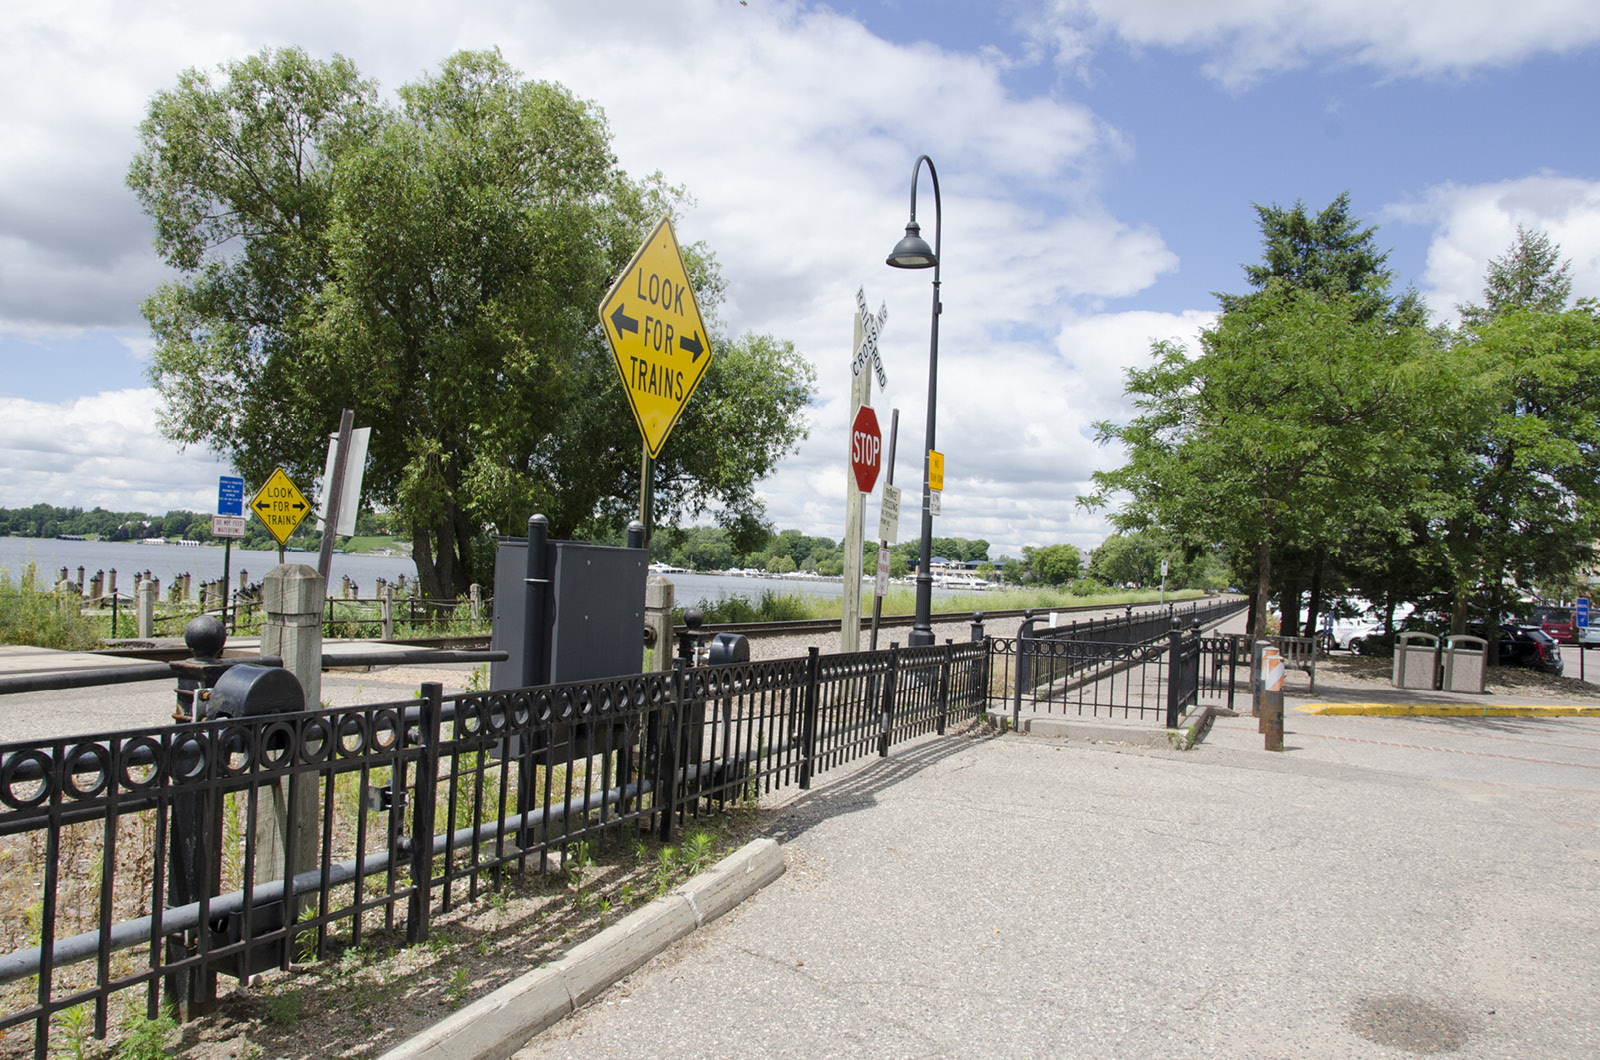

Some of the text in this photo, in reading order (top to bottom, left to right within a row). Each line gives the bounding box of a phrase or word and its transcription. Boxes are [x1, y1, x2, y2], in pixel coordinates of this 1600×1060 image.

[637, 267, 686, 317] LOOK
[644, 315, 675, 356] FOR
[852, 304, 888, 377] CROSSING
[630, 355, 684, 402] TRAINS
[871, 346, 887, 388] ROAD
[853, 430, 881, 467] STOP
[267, 487, 294, 499] LOOK
[273, 501, 290, 512] FOR
[267, 514, 297, 526] TRAINS
